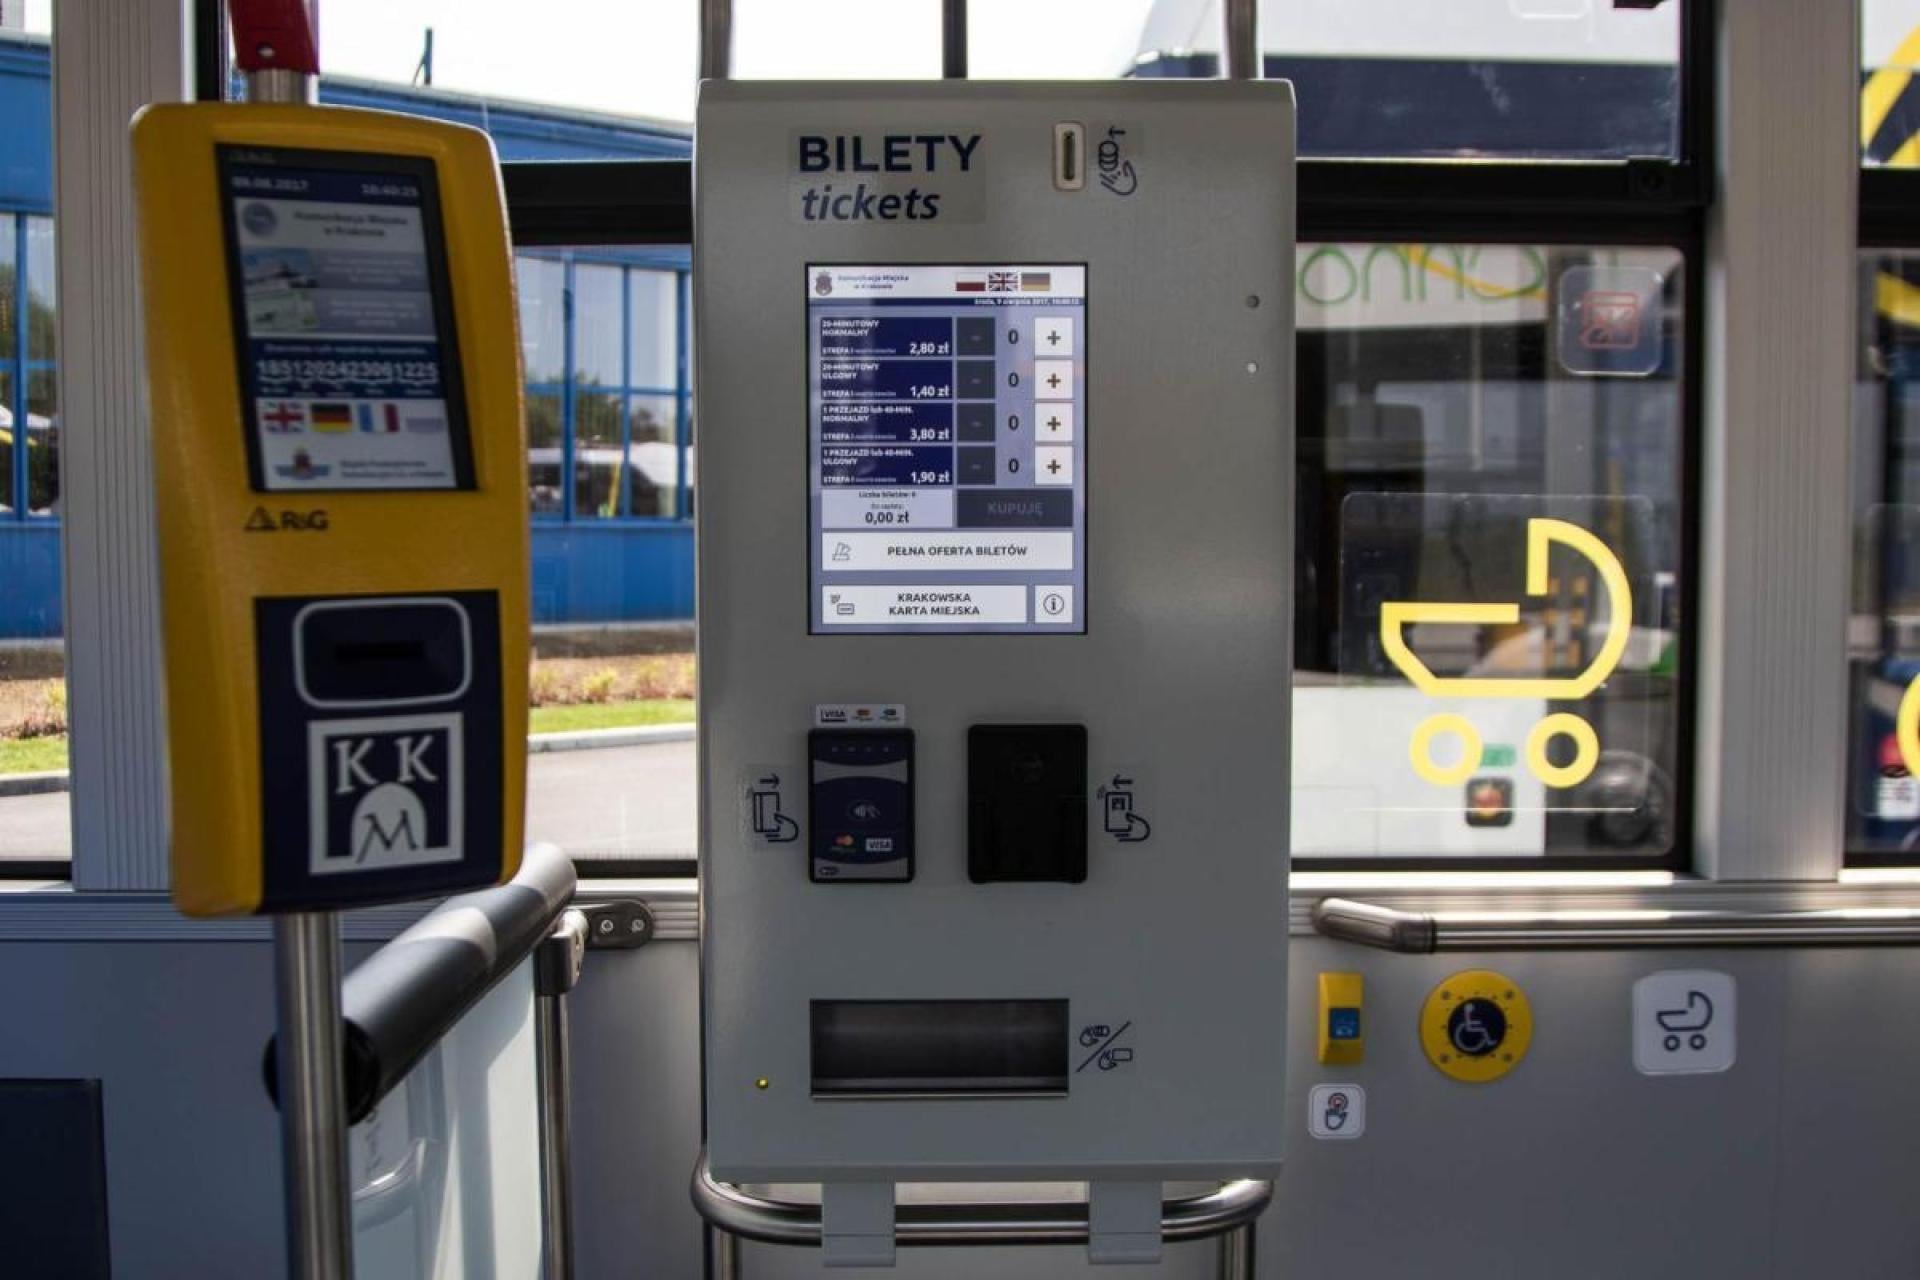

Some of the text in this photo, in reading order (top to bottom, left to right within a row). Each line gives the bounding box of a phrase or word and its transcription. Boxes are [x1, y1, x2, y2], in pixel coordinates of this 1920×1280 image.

[799, 135, 982, 173] BILETY
[801, 183, 941, 221] tickets
[822, 329, 869, 337] NORMALNY
[1008, 329, 1019, 345] 0
[909, 342, 936, 355] 2,80
[937, 342, 950, 354] zł
[822, 372, 857, 380] ULGOWY
[1008, 372, 1019, 388] 0
[909, 386, 936, 399] 1,40
[937, 385, 950, 397] zł
[829, 406, 869, 414] PRZEJAZD
[822, 415, 870, 423] NORMALNY
[1008, 415, 1019, 431] 0
[909, 428, 936, 441] 3,80
[937, 428, 950, 440] zł
[829, 449, 869, 457] PRZEJAZD
[823, 457, 858, 465] ULGOWY
[1008, 458, 1019, 474] 0
[909, 471, 936, 484] 1,90
[937, 471, 950, 483] zł
[987, 501, 1043, 517] KUPUJĘ
[865, 511, 910, 525] 0,00 zł
[887, 544, 1028, 556] PEŁNA OFERTA BILETÓW
[898, 593, 972, 602] KRAKOWSKA
[889, 606, 980, 616] KARTA MIEJSKA
[333, 734, 438, 794] K K
[355, 809, 421, 864] M
